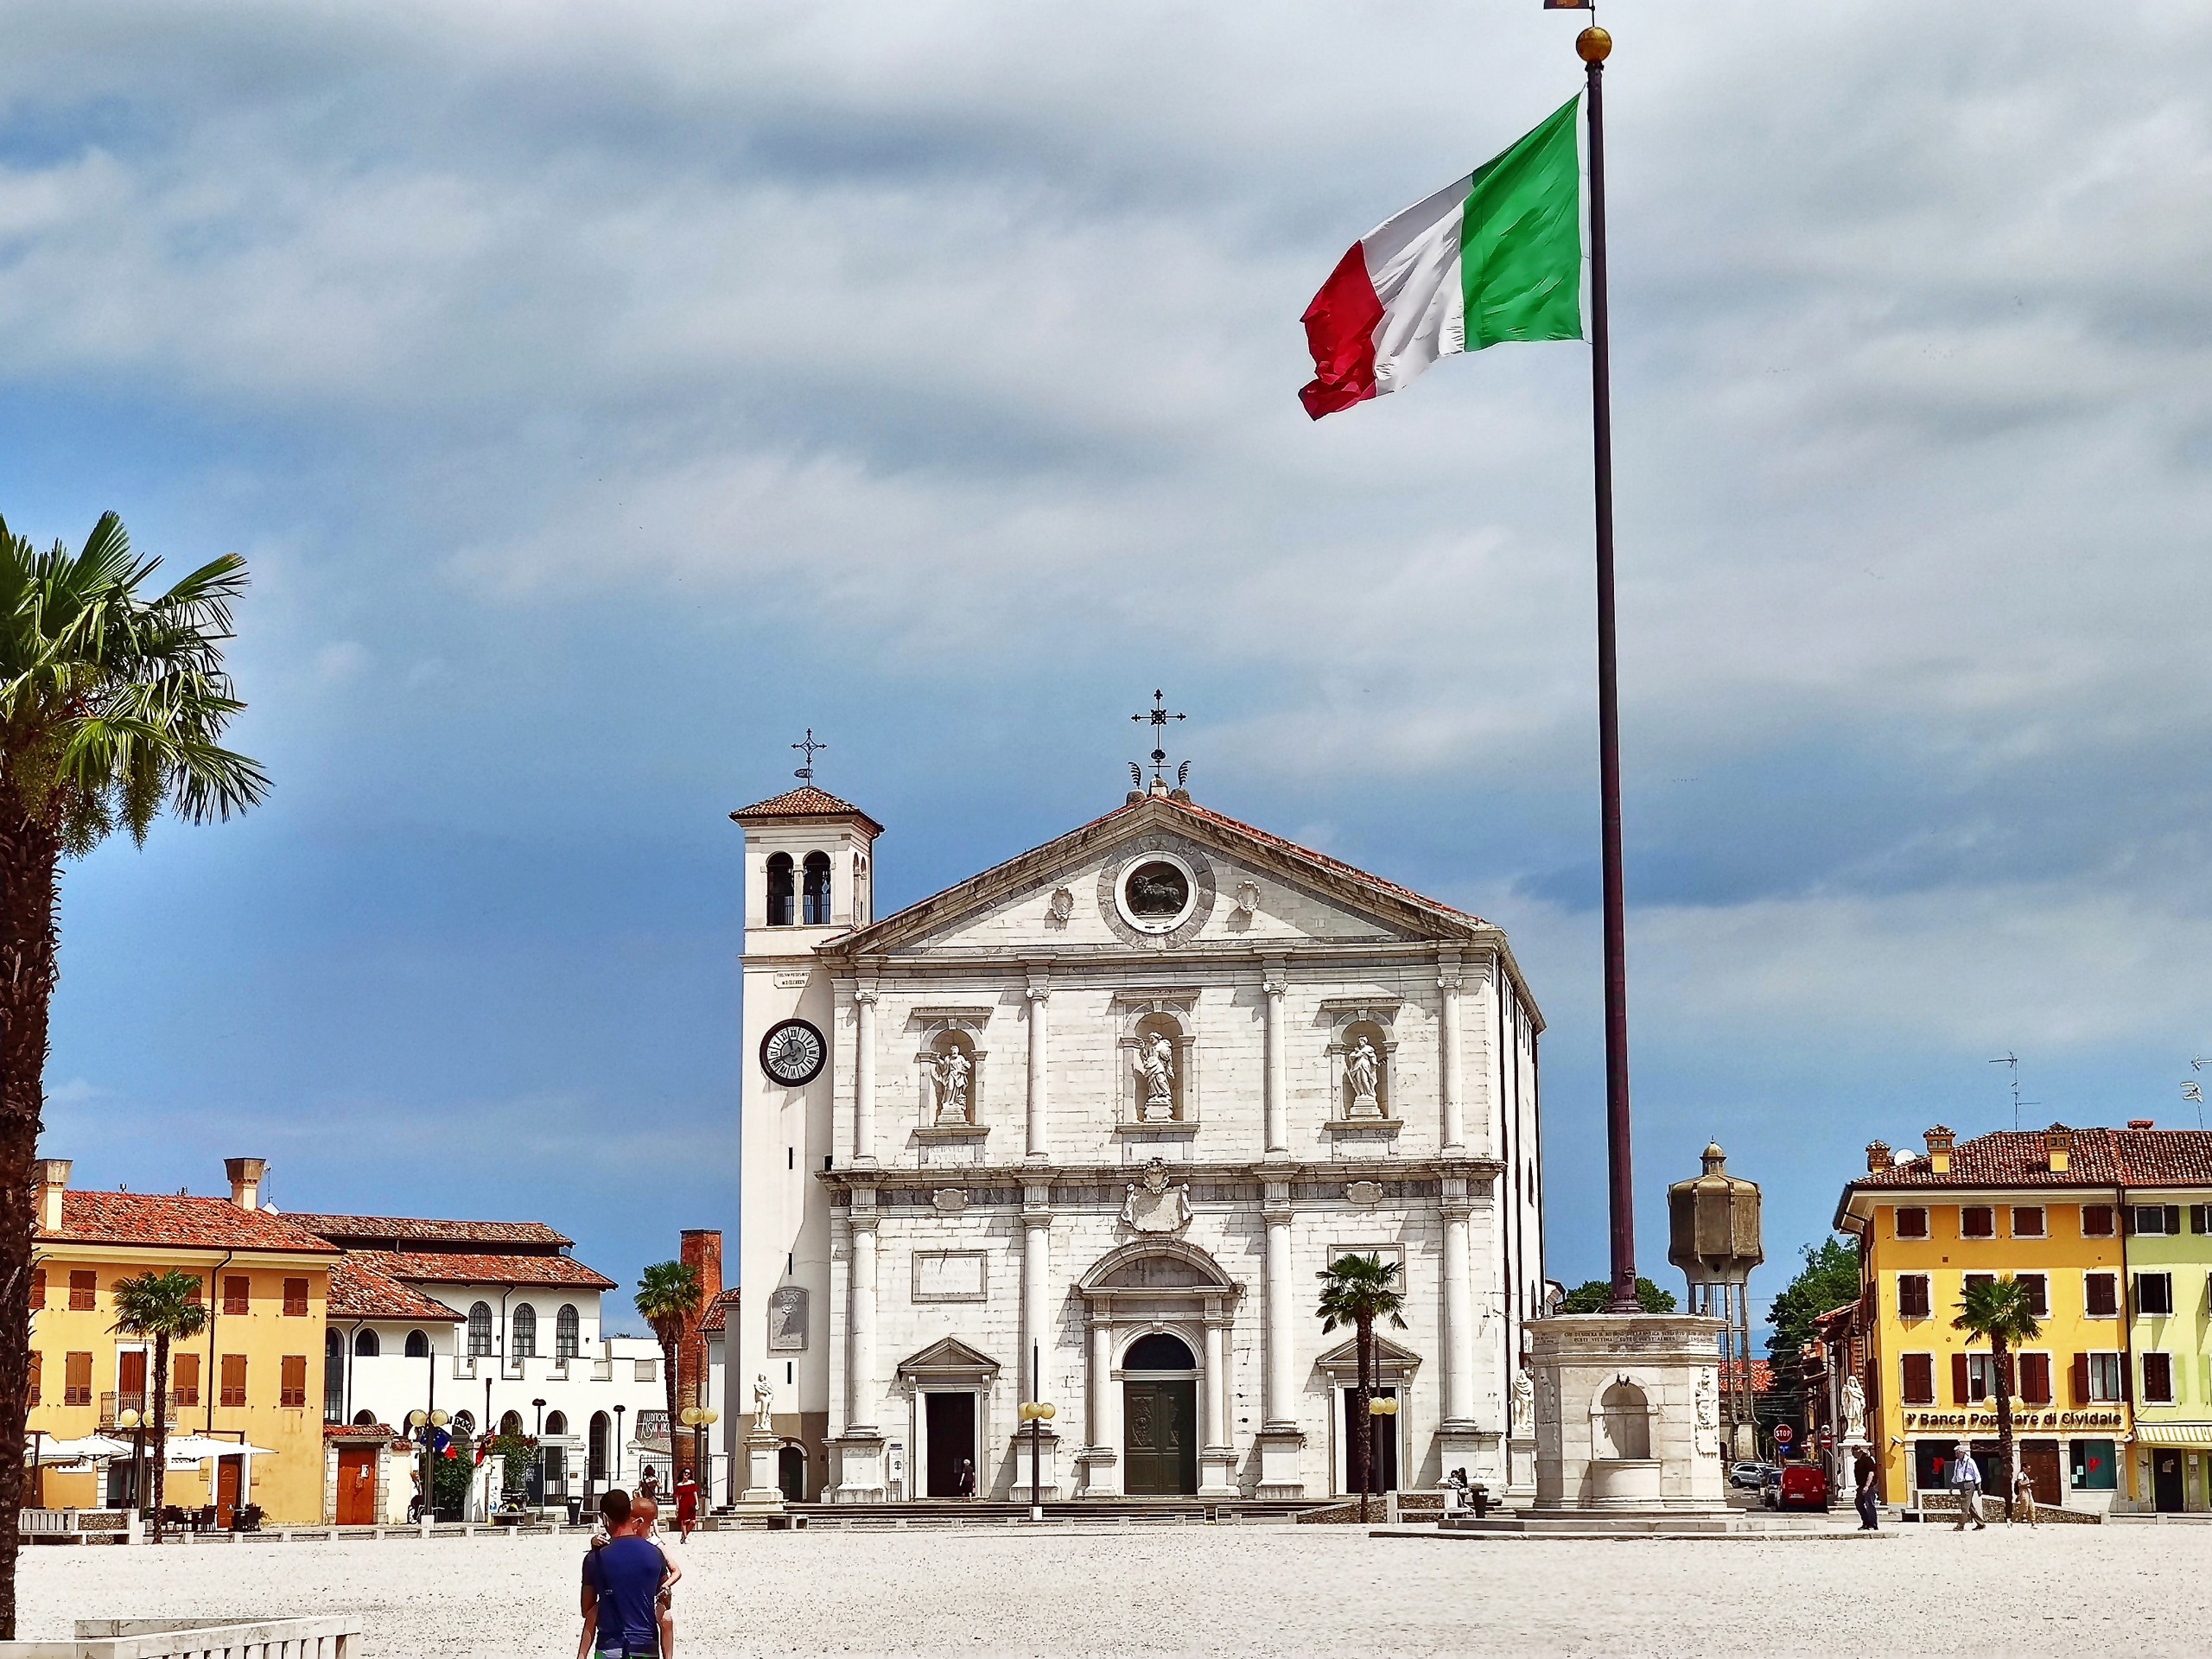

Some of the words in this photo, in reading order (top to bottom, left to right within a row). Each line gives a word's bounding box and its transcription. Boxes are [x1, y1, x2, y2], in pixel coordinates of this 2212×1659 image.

[1920, 1414, 1966, 1425] Banca
[1970, 1414, 2039, 1427] Poplare
[2044, 1413, 2057, 1425] di
[2062, 1413, 2122, 1425] Cividale
